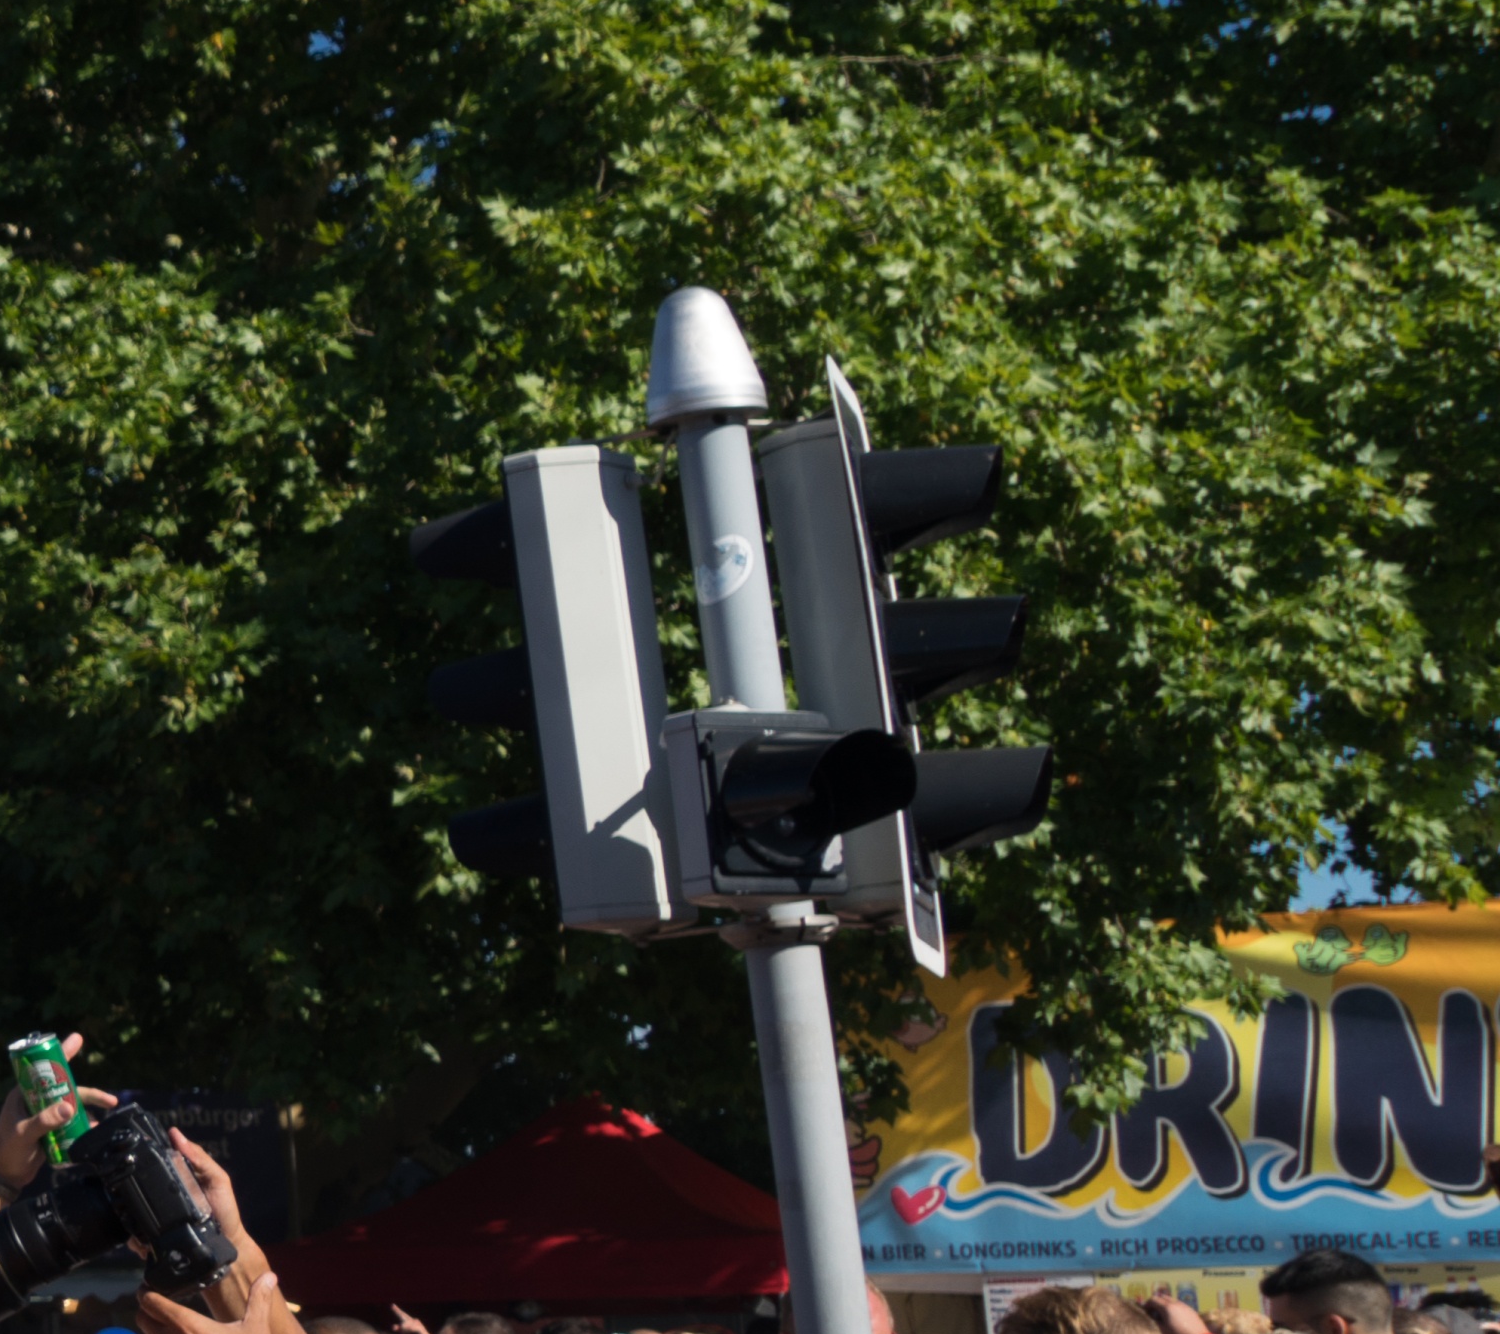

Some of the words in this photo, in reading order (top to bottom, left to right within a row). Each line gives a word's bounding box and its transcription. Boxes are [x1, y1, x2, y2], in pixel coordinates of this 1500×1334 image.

[967, 982, 1500, 1200] DRIN
[882, 1242, 926, 1261] BIER
[949, 1239, 1077, 1261] LONGDRINKS
[1100, 1237, 1149, 1257] RICH
[1156, 1234, 1266, 1256] PROSECCO
[1289, 1229, 1442, 1252] TROPICAL-ICE
[1466, 1229, 1500, 1249] RE
